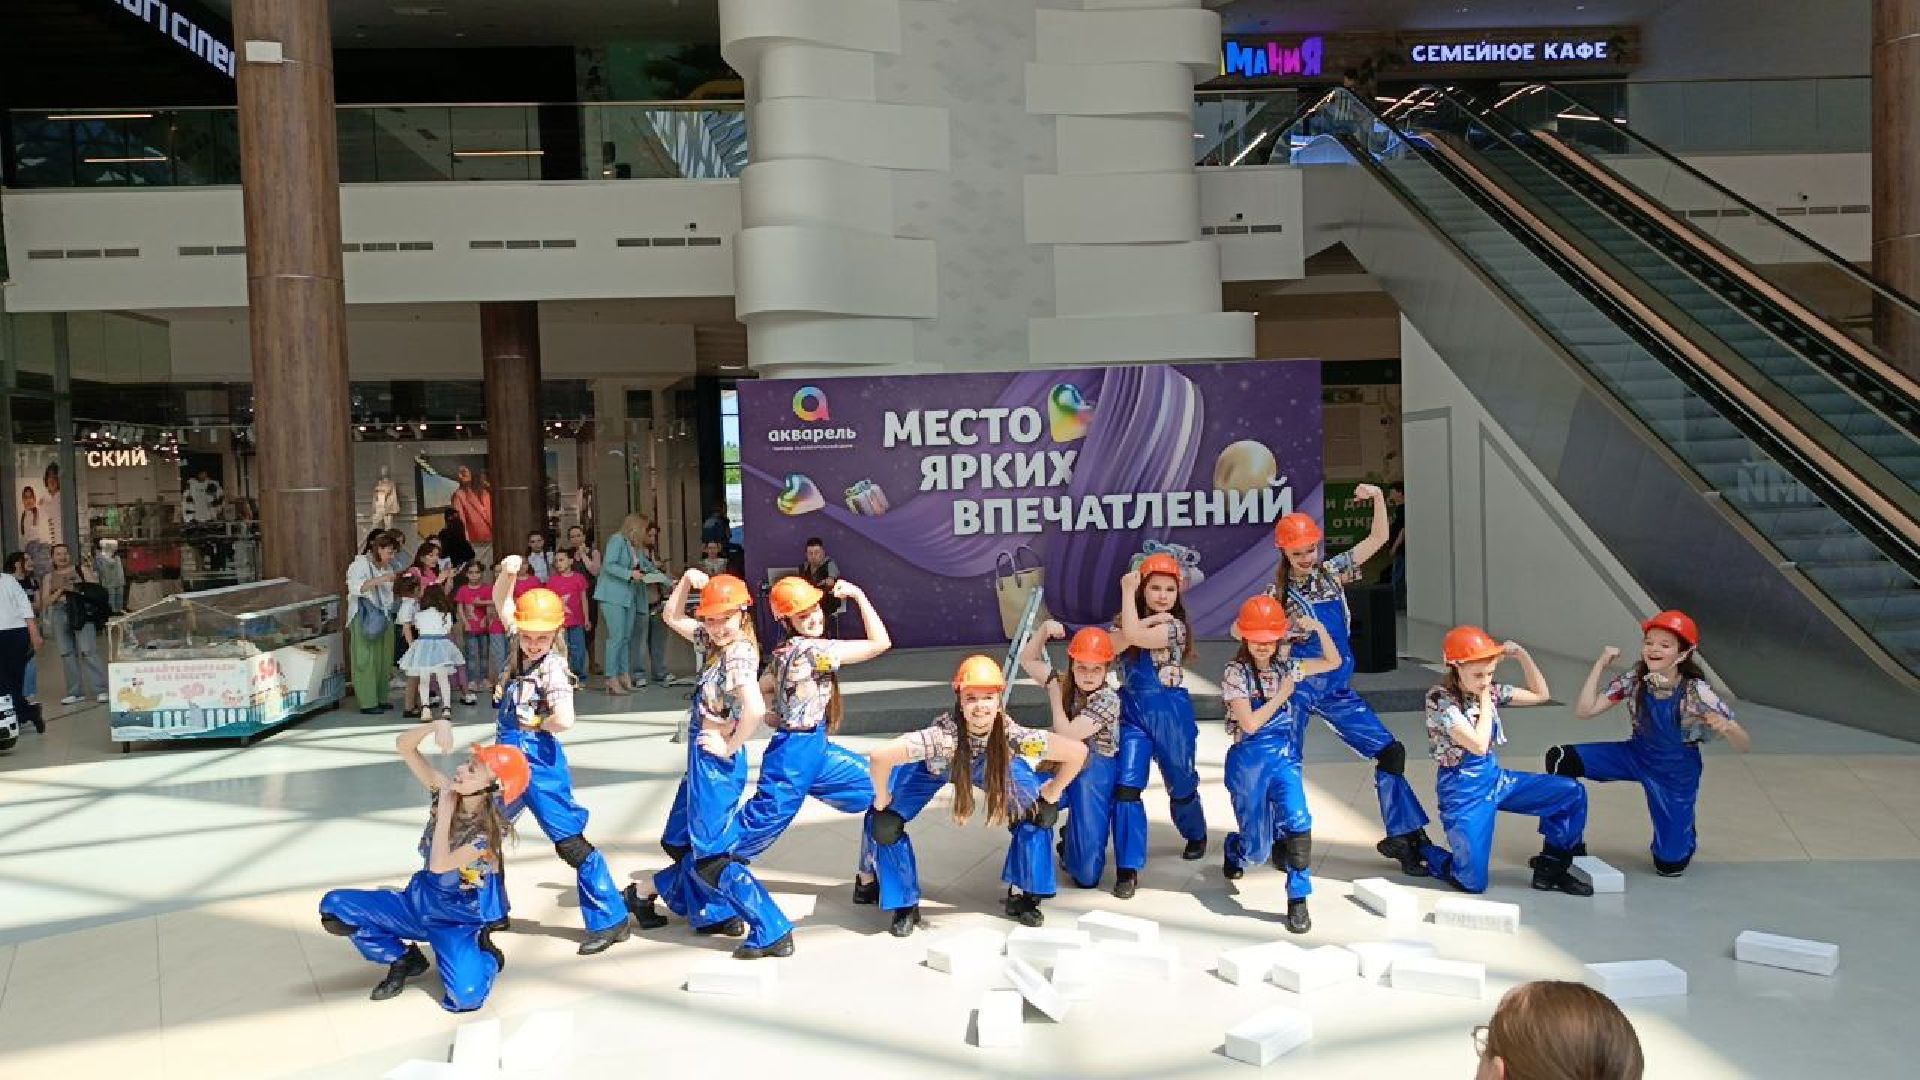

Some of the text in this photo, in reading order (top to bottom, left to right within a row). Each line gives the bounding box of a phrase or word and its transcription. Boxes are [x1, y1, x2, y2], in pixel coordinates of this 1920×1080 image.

[172, 12, 235, 78] cine
[1411, 40, 1607, 62] СЕМЕЙНОЕ КАФЕ
[768, 428, 857, 443] акварель
[883, 405, 1042, 448] МЕСТО
[920, 450, 1078, 491] ЯРКИХ
[953, 475, 1293, 536] ВПЕЧАТЛЕНИЙ
